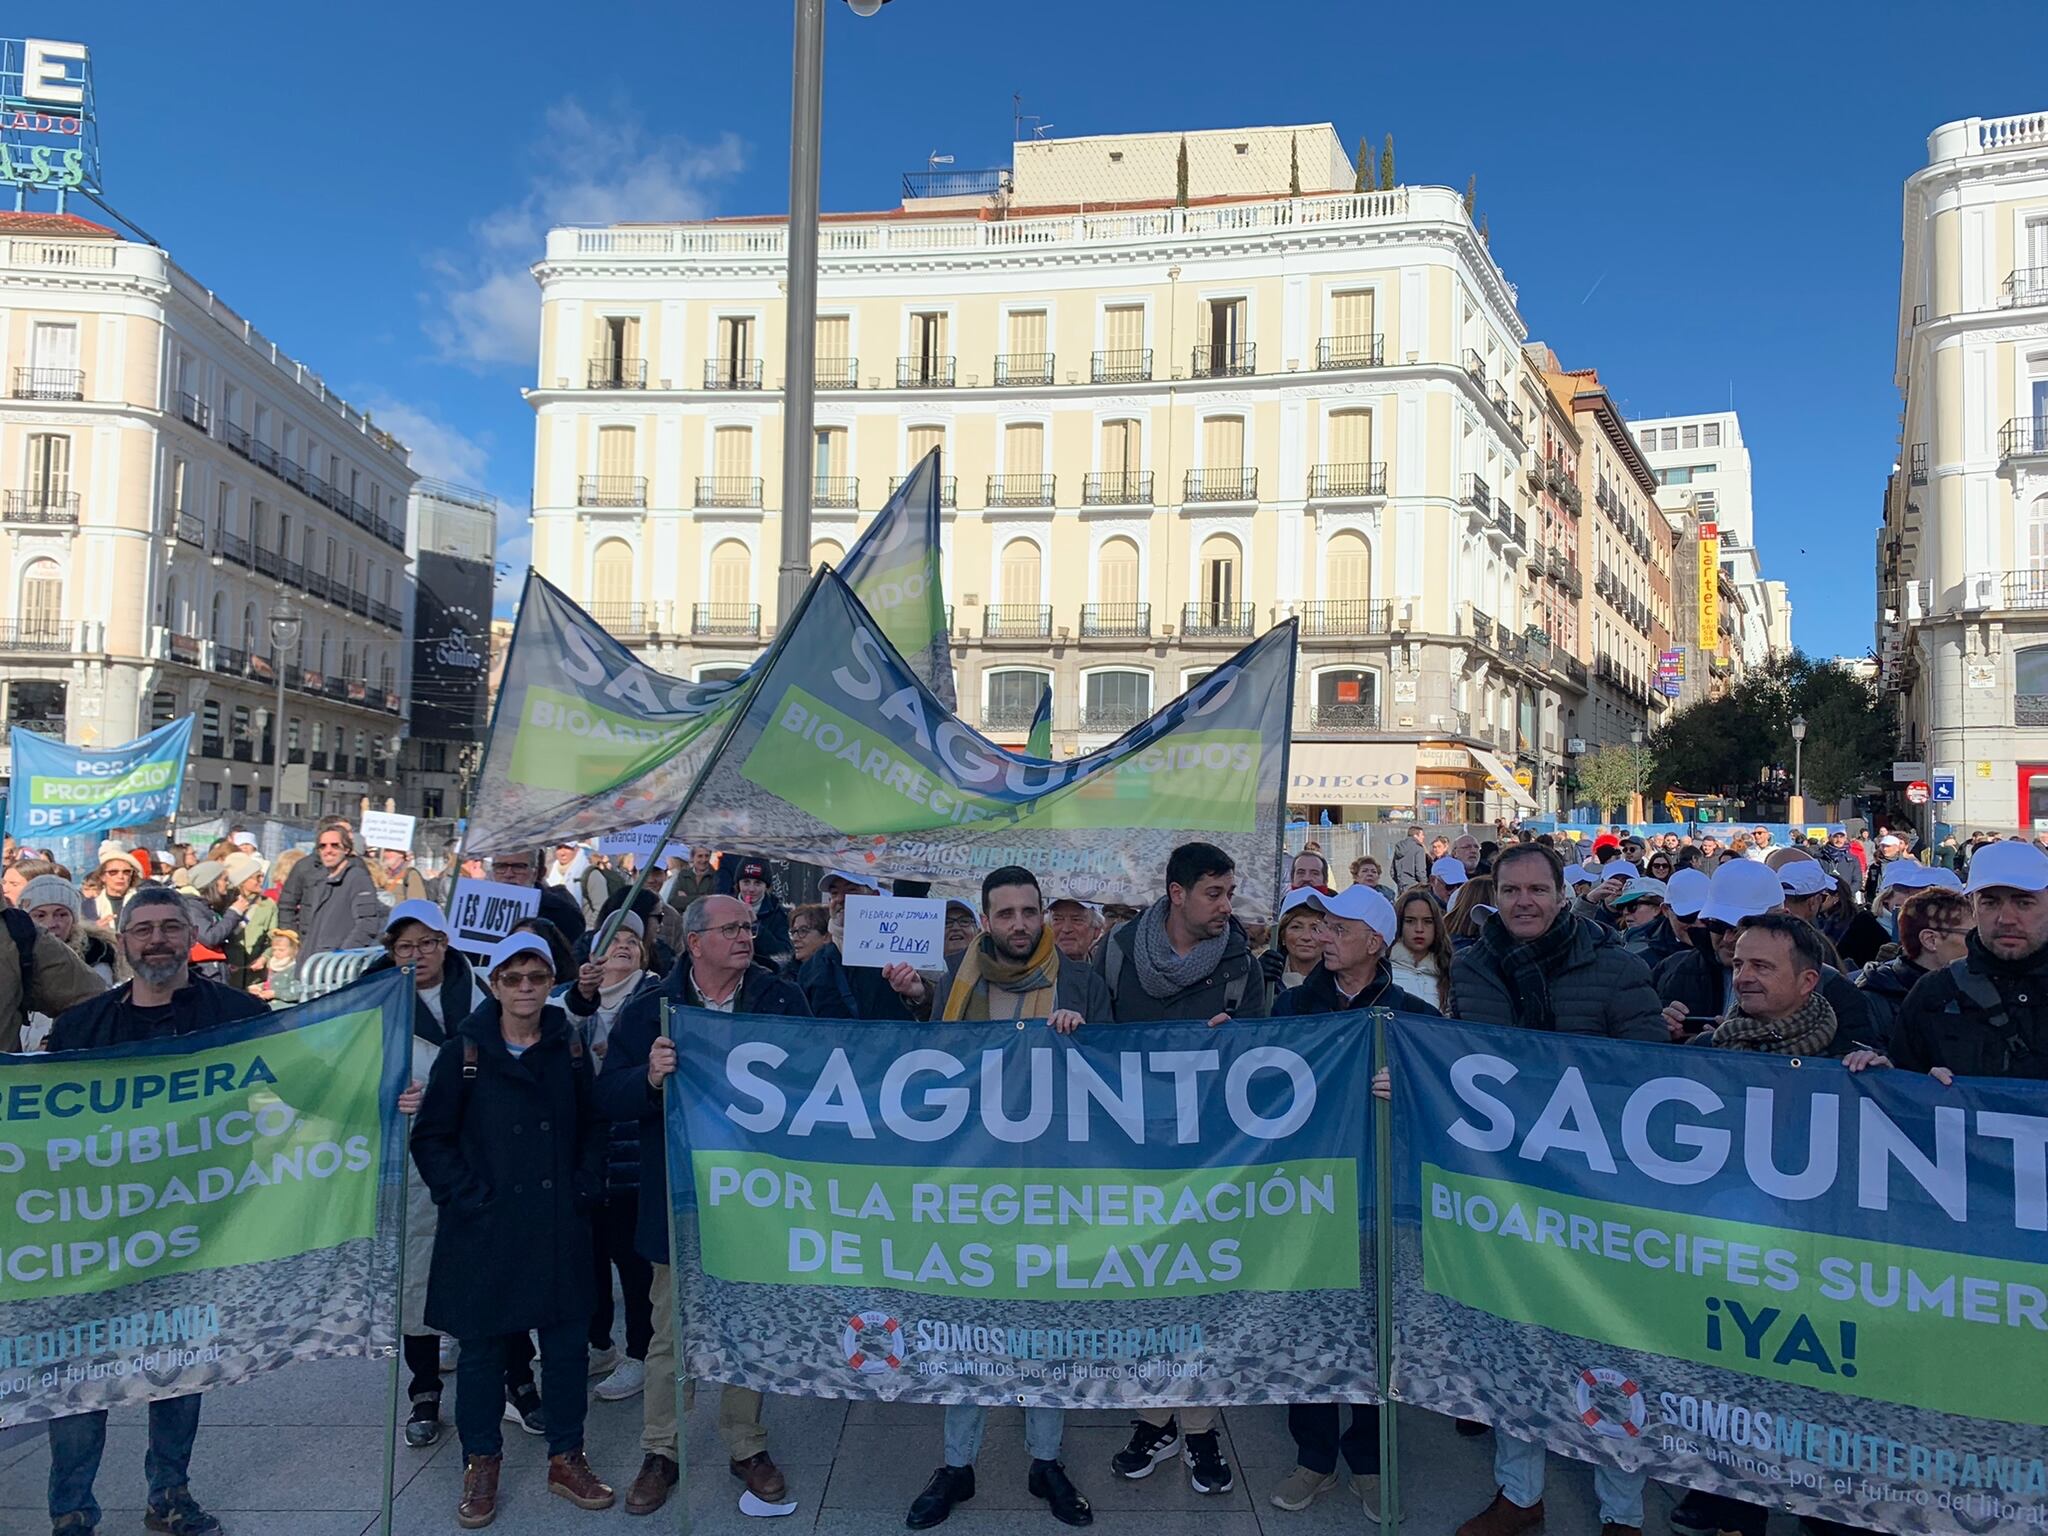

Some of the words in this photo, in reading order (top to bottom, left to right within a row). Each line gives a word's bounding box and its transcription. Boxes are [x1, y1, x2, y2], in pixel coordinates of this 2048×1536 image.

[23, 38, 87, 103] E
[0, 112, 80, 135] ADO
[1293, 773, 1410, 788] DIEGO
[1301, 792, 1390, 800] PARAGUAS
[29, 808, 62, 826] DE
[880, 921, 899, 932] NO
[890, 935, 930, 952] PLAYA
[0, 1055, 278, 1121] ECUPERA
[724, 1040, 1319, 1145] SAGUNTO
[1445, 1052, 2048, 1232] SAGUNT
[15, 1135, 372, 1224] CIUDADANOS
[709, 1166, 815, 1211] POR
[827, 1177, 896, 1221] LA
[911, 1167, 1336, 1226] REGENERACIÓN
[0, 1224, 201, 1283] CIPIOS
[787, 1226, 864, 1275] DE
[881, 1240, 997, 1287] LAS
[1016, 1237, 1244, 1290] PLAYAS
[1431, 1182, 1800, 1291] BIOARRECIFES
[1818, 1257, 2048, 1331] SUMER
[1705, 1297, 1858, 1379] ¡YA!
[0, 1374, 33, 1400] por
[41, 1366, 59, 1388] el
[66, 1360, 128, 1384] futuro
[133, 1354, 160, 1373] del
[168, 1342, 222, 1369] litoral
[919, 1362, 949, 1377] nos
[954, 1359, 1014, 1377] unimos
[1020, 1367, 1047, 1382] por
[1053, 1360, 1066, 1381] el
[1072, 1360, 1121, 1380] futuro
[1127, 1359, 1151, 1379] del
[1157, 1359, 1205, 1379] litoral
[1663, 1432, 1699, 1456] nos
[1707, 1443, 1781, 1481] unimos
[1790, 1468, 1824, 1491] por
[1834, 1471, 1853, 1494] el
[1861, 1477, 1930, 1506] futuro
[1937, 1488, 1973, 1513] del
[1978, 1491, 2047, 1524] litoral
